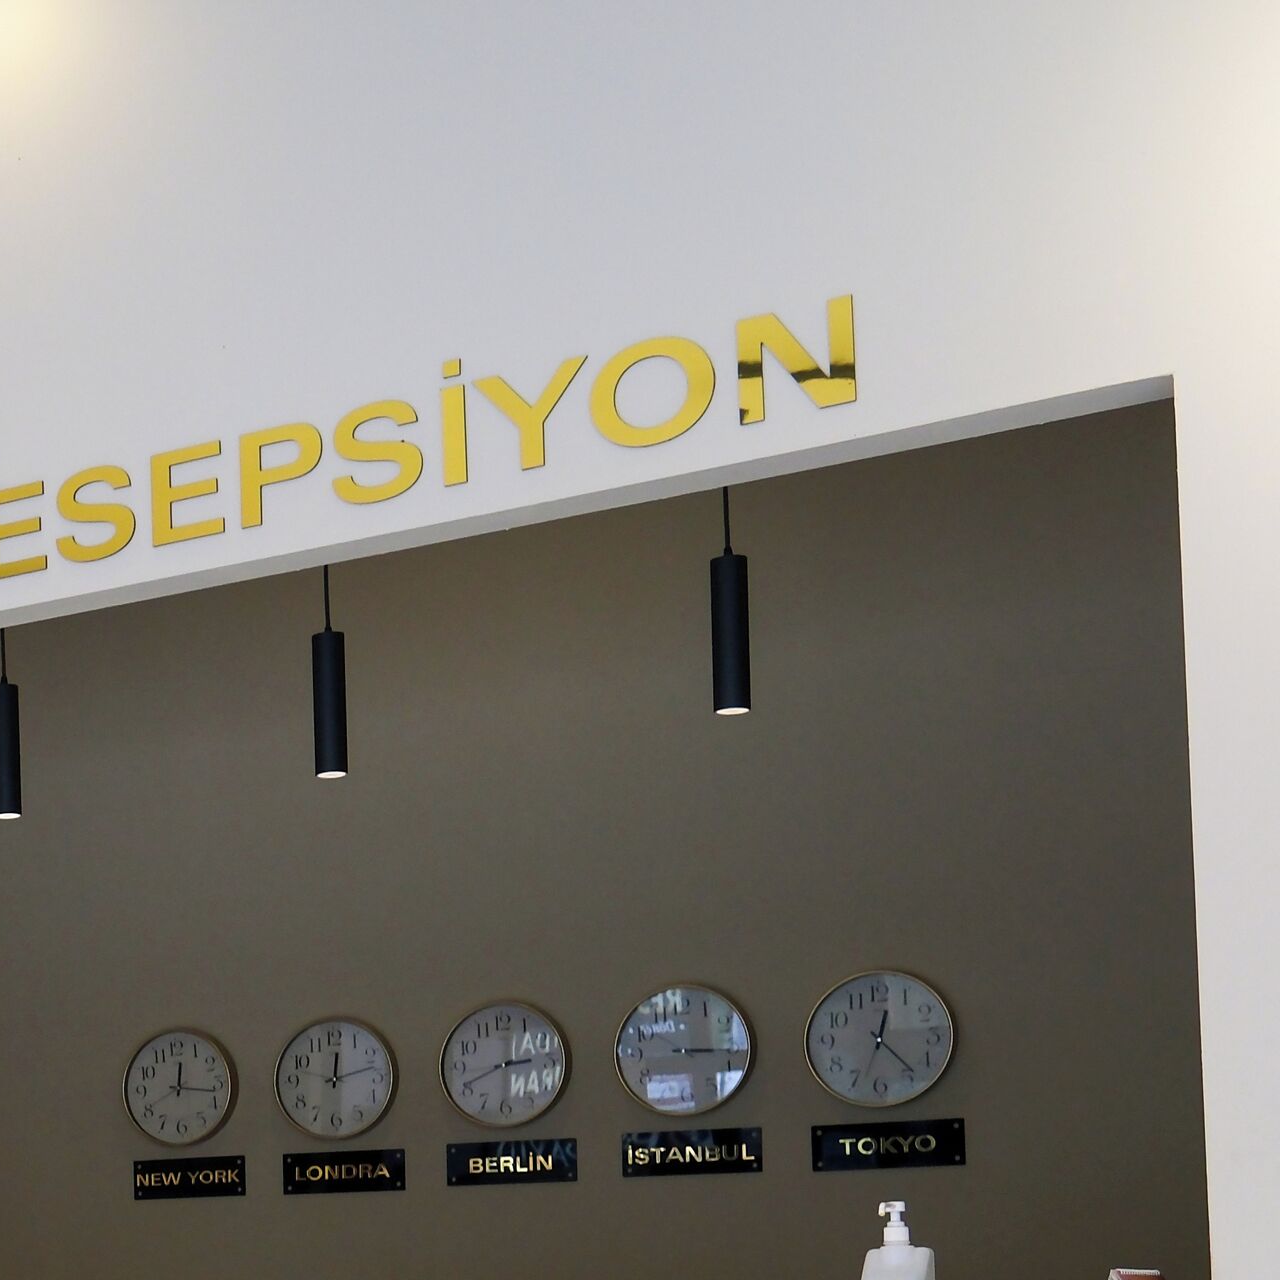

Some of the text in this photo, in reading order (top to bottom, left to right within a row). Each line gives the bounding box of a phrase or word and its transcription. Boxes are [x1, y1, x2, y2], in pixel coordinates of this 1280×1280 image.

[848, 993, 863, 1010] 11
[870, 984, 889, 1002] 12
[830, 1012, 848, 1029] 10
[918, 1004, 931, 1023] 2
[310, 1037, 321, 1053] 11
[327, 1030, 342, 1046] 12
[821, 1034, 835, 1050] 9
[154, 1048, 165, 1064] 11
[170, 1039, 183, 1056] 12
[365, 1048, 376, 1063] 2
[205, 1056, 216, 1072] 2
[295, 1054, 310, 1070] 10
[829, 1056, 843, 1073] 8
[141, 1065, 155, 1081] 10
[288, 1074, 299, 1089] 9
[849, 1071, 861, 1092] 7
[136, 1084, 147, 1098] 9
[873, 1077, 888, 1097] 6
[144, 1103, 154, 1119] 8
[295, 1095, 306, 1110] 8
[159, 1114, 167, 1133] 7
[312, 1106, 320, 1125] 7
[330, 1113, 343, 1128] 6
[176, 1119, 188, 1135] 6
[839, 1134, 936, 1156] TOKYO
[627, 1143, 755, 1165] İSTANBUL
[469, 1152, 553, 1174] BERLİN
[136, 1169, 240, 1187] NEW YORK
[295, 1163, 391, 1181] LONDRA
